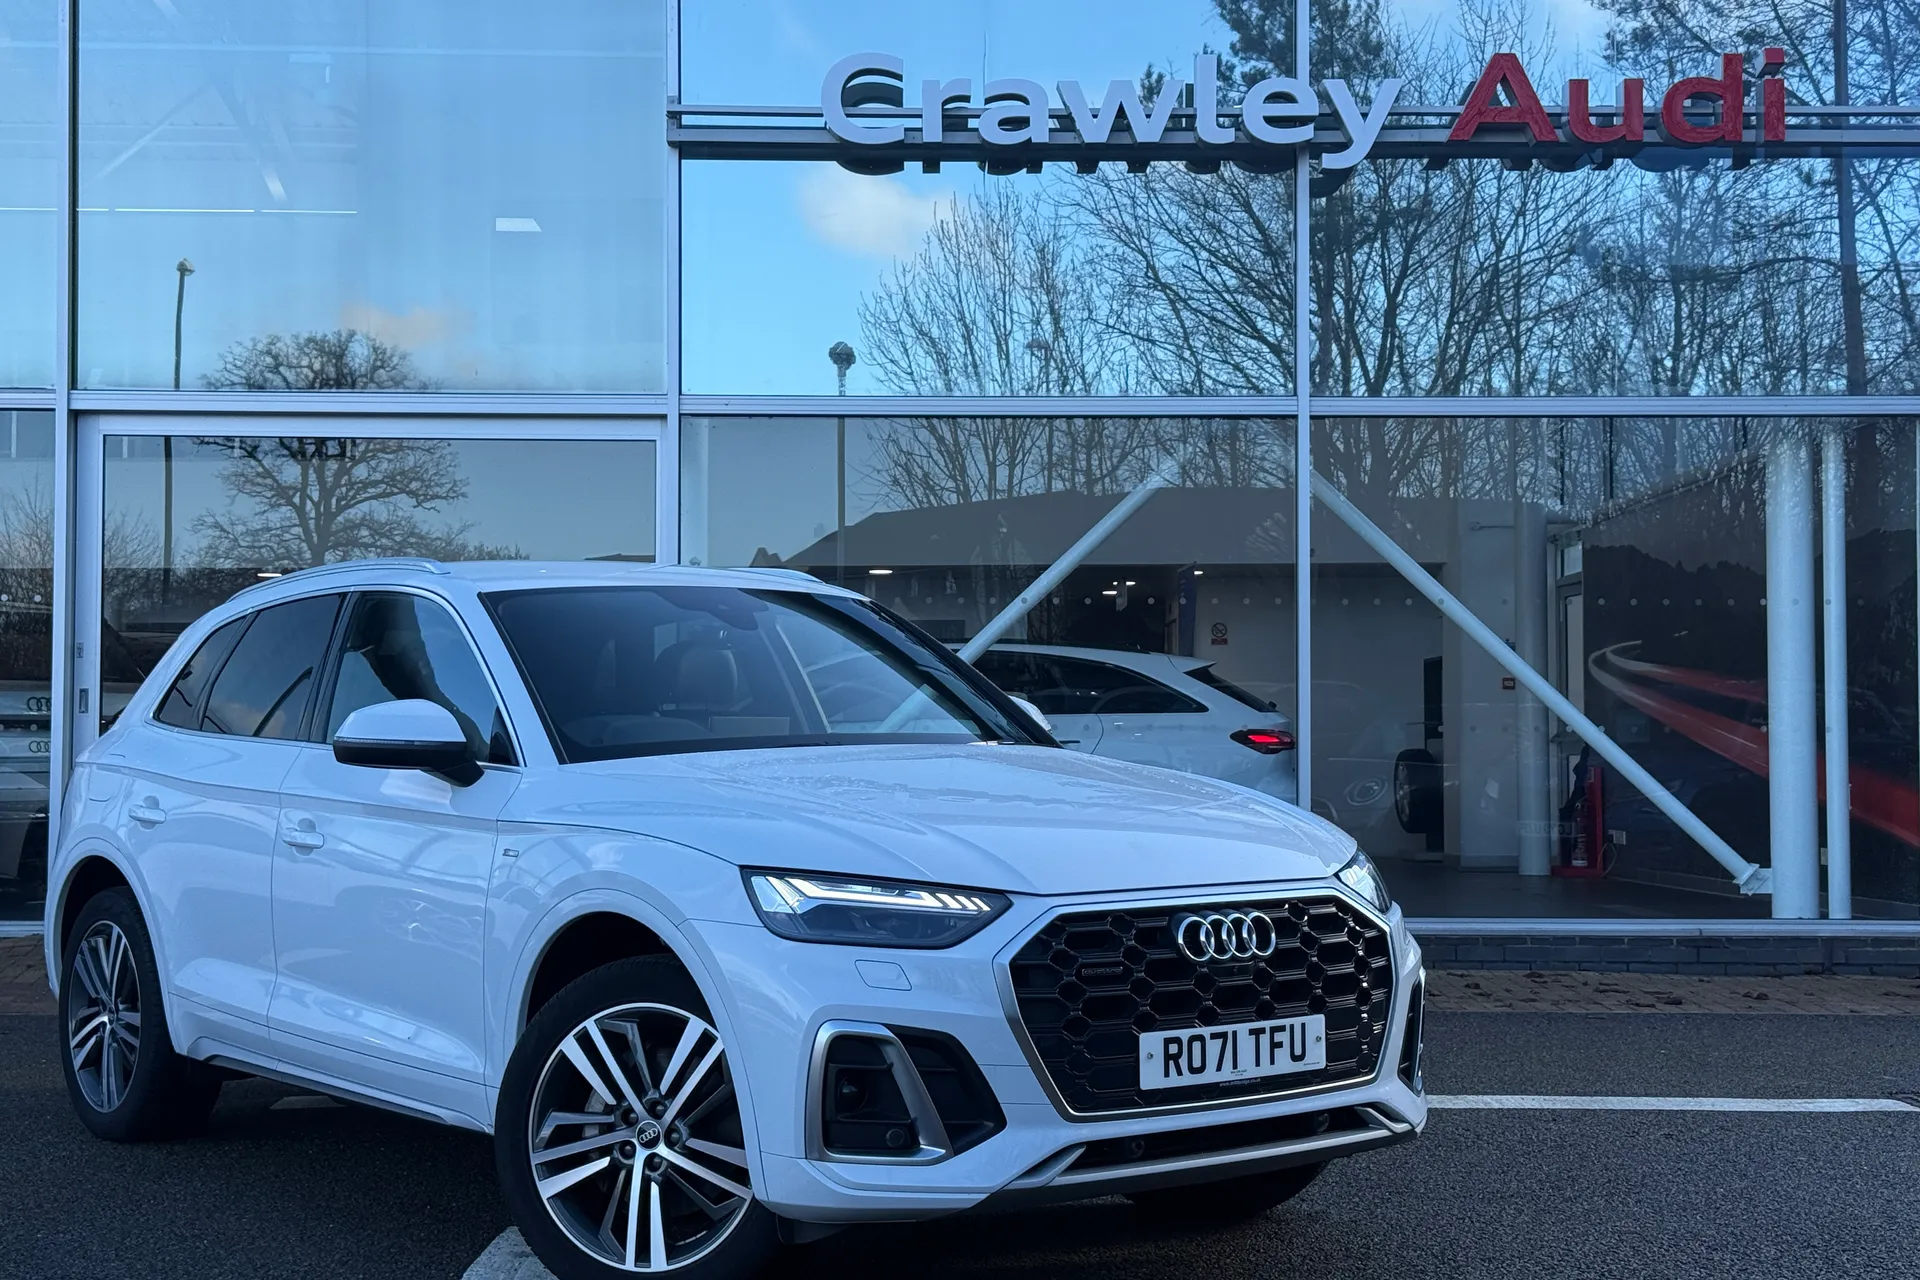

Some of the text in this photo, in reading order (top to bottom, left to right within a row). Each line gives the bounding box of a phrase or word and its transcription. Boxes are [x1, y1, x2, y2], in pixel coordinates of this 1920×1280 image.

[821, 48, 1786, 170] Crawley Audi
[1163, 1022, 1306, 1078] RO71 TFU
